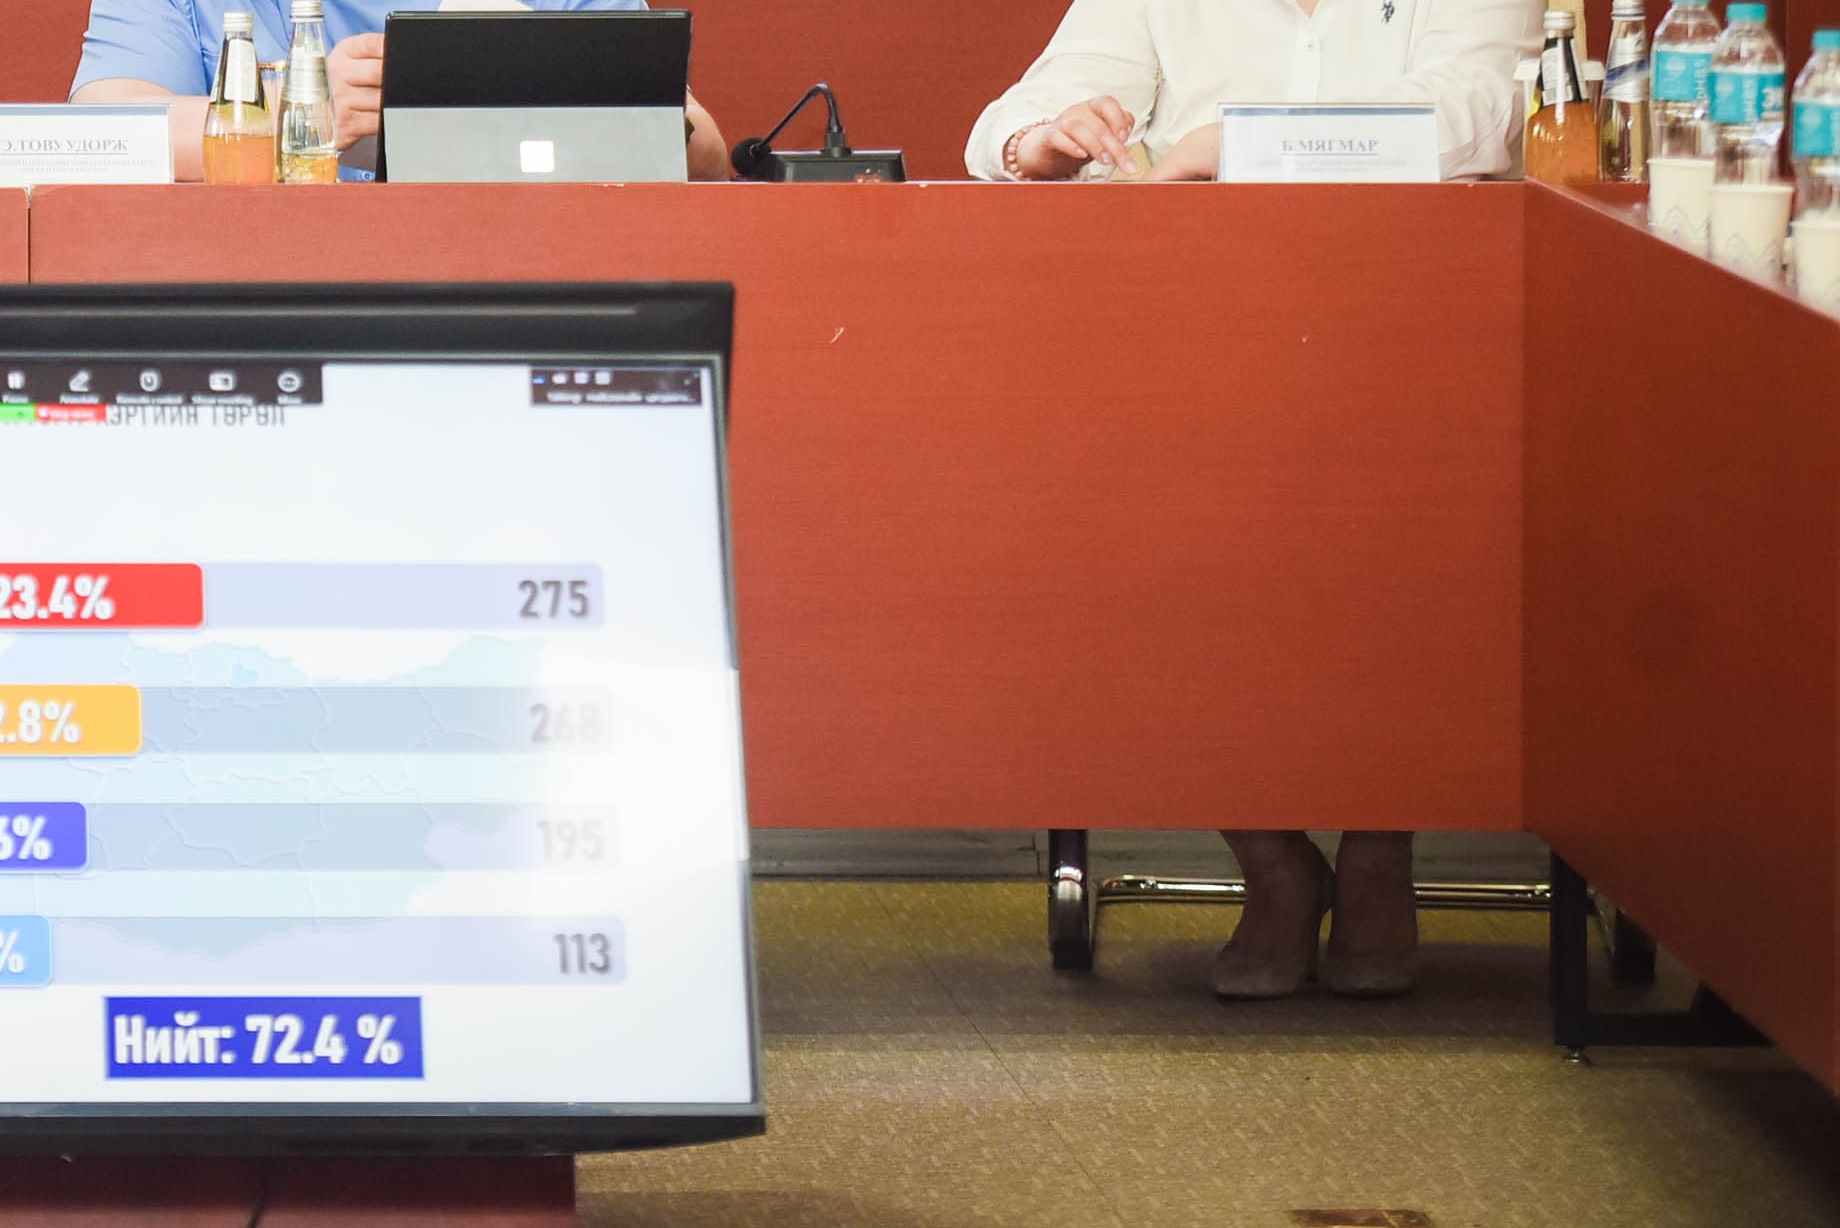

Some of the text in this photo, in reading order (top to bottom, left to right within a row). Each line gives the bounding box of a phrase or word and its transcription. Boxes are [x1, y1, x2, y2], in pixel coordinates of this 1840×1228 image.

[518, 579, 590, 619] 275
[529, 702, 602, 744] 268
[536, 819, 605, 862] 195
[552, 932, 613, 975] 113
[113, 1010, 403, 1065] Нийт: 72.4 %
